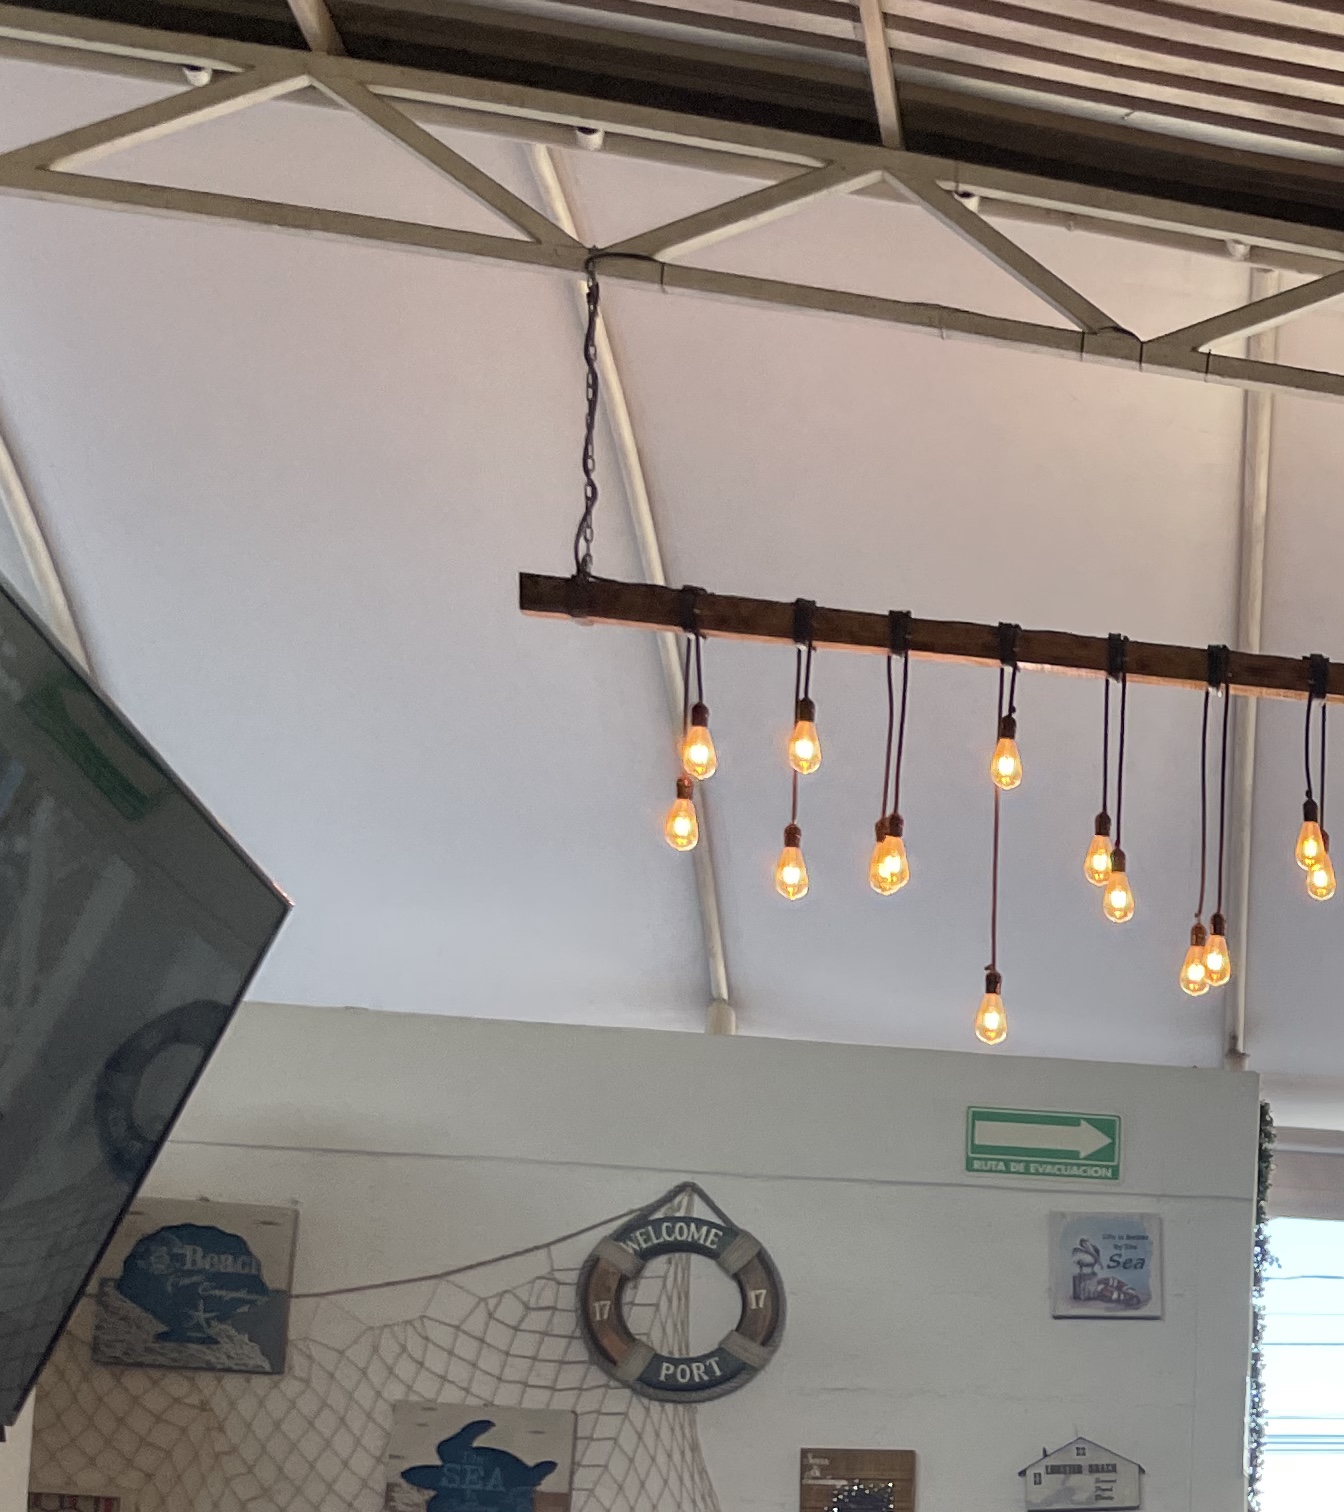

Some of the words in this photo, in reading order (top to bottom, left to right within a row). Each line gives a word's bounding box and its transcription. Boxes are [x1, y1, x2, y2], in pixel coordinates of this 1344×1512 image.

[973, 1160, 1006, 1171] RUTA
[1010, 1162, 1025, 1172] DE
[619, 1221, 723, 1254] WELCOME
[1107, 1253, 1146, 1270] Sea
[750, 1289, 768, 1310] 17
[594, 1300, 612, 1321] 17
[659, 1357, 724, 1383] PORT
[438, 1464, 506, 1492] SEA
